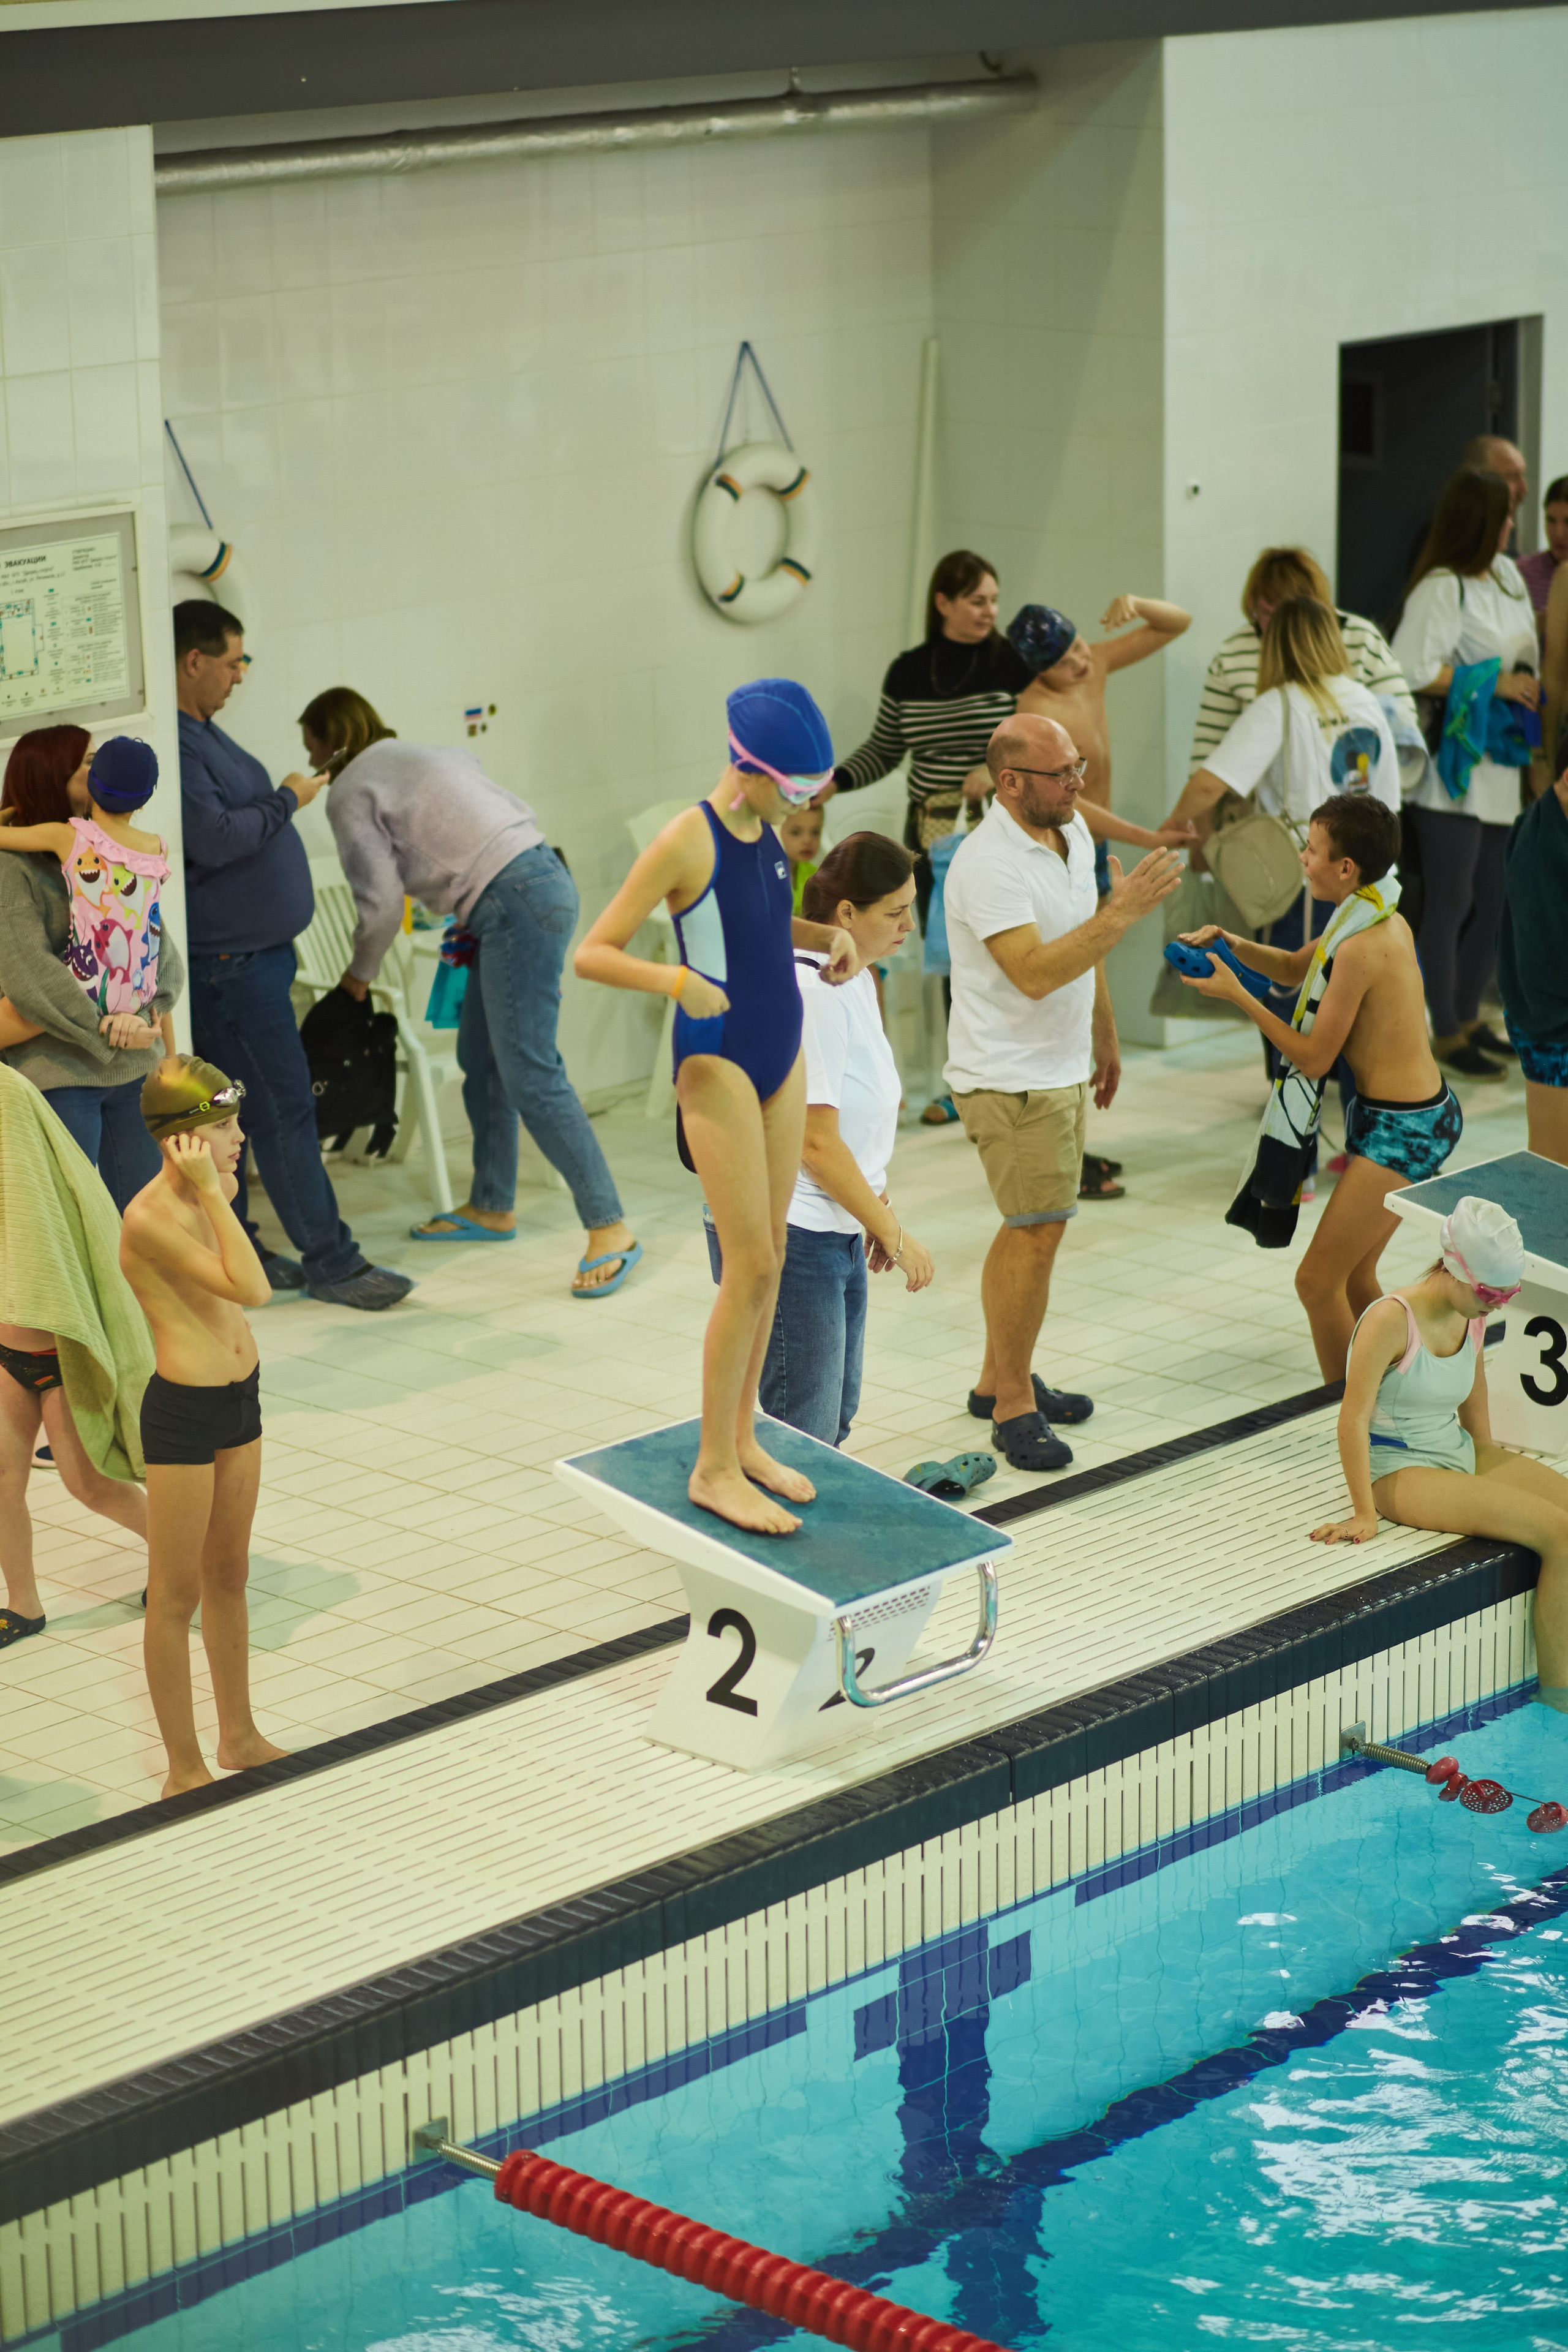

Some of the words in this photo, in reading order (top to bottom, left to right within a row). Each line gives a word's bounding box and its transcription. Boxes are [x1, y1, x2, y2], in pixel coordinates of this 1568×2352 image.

[4, 556, 46, 568] ЭВАКУАЦИИ
[1520, 1316, 1568, 1406] 3
[706, 1608, 757, 1717] 2
